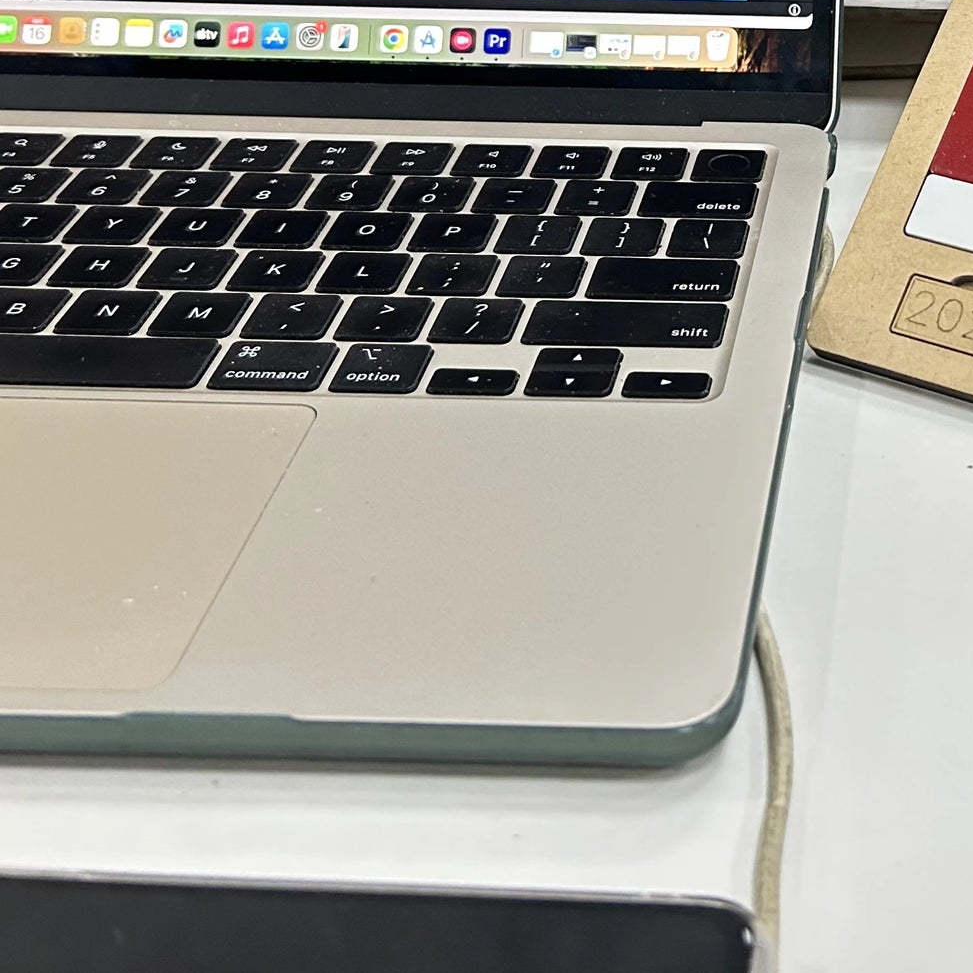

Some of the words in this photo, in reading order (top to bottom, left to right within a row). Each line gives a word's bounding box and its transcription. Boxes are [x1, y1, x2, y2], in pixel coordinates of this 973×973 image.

[488, 33, 508, 47] Pr
[696, 202, 742, 211] delete
[672, 282, 720, 291] return
[671, 327, 708, 337] shift
[224, 369, 309, 381] command
[346, 371, 400, 383] option
